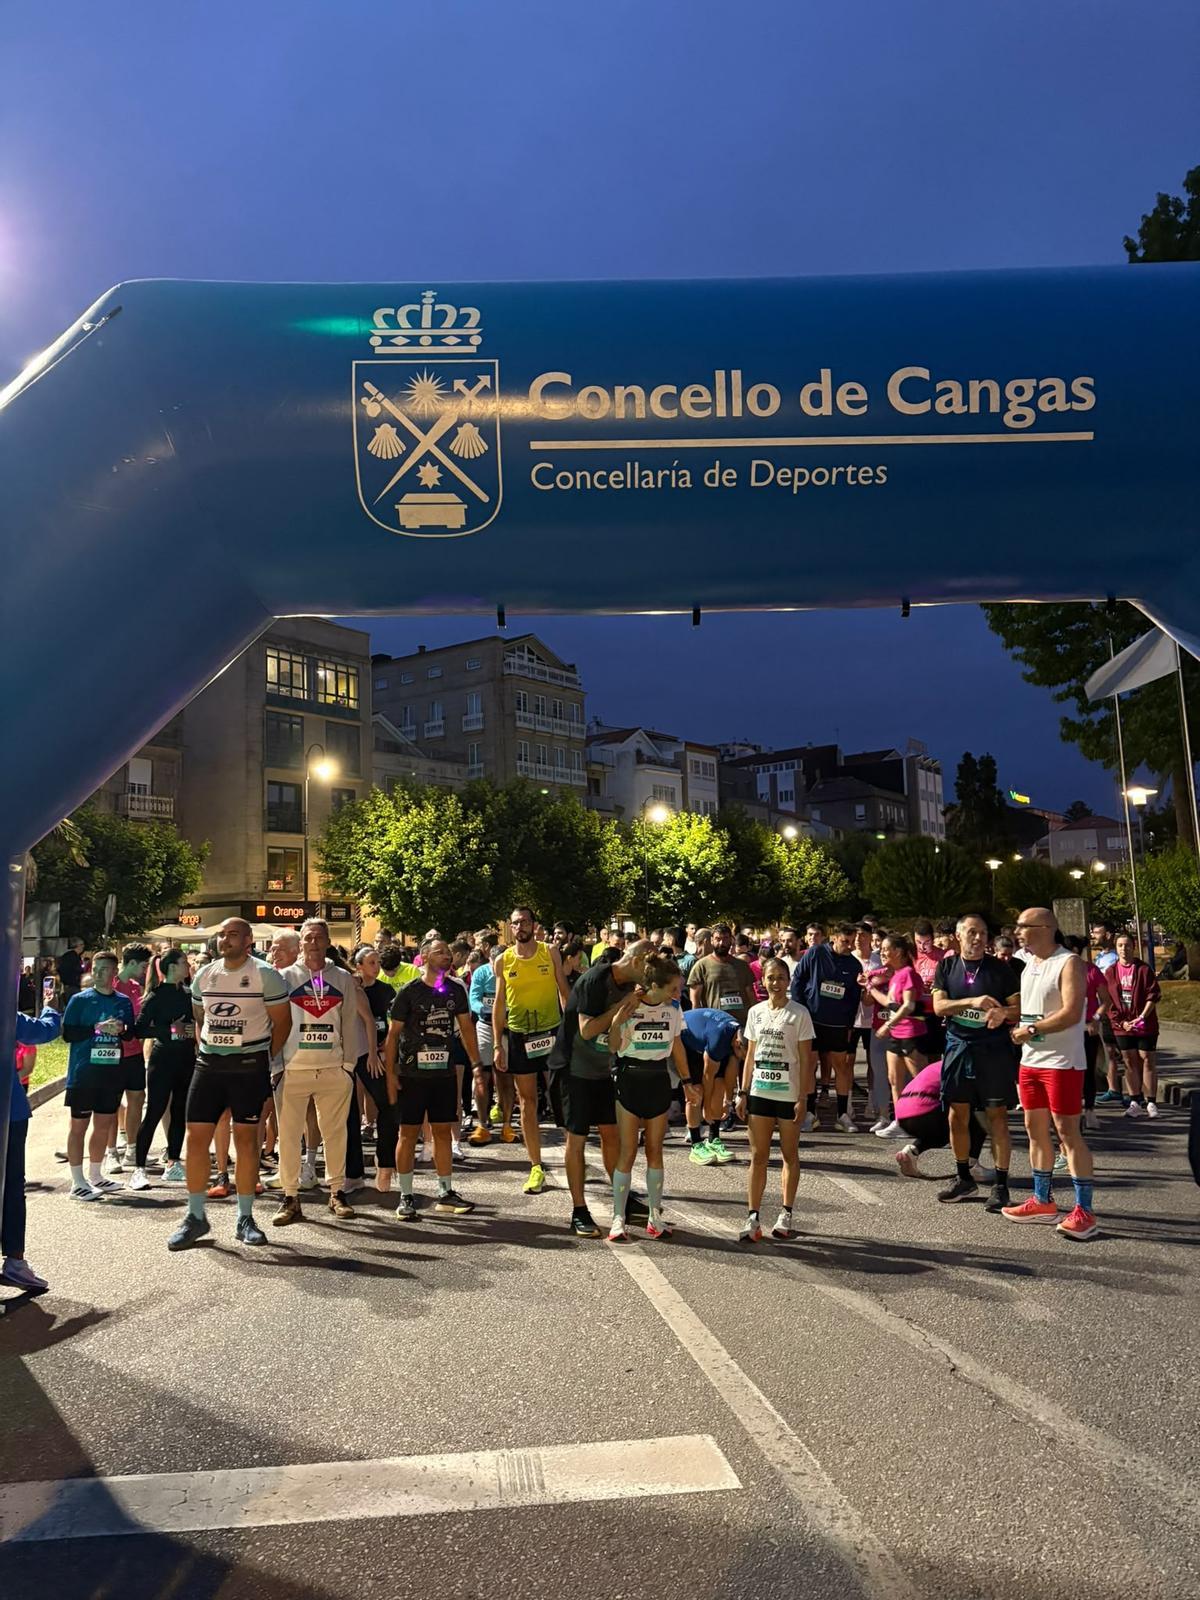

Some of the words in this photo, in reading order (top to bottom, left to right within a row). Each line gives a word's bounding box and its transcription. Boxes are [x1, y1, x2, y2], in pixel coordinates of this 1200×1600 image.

[528, 369, 781, 421] Concello
[800, 368, 868, 416] de
[887, 366, 1097, 429] Cangas
[530, 459, 693, 491] Concellaría
[703, 460, 738, 488] de
[750, 459, 888, 495] Deportes
[272, 905, 305, 919] Orange
[178, 913, 200, 926] range
[303, 999, 330, 1007] adias
[212, 1035, 235, 1045] 0365
[306, 1033, 328, 1042] 0140
[641, 1032, 664, 1041] 0744
[531, 1039, 551, 1050] 0609
[97, 1049, 116, 1057] 0266
[425, 1052, 445, 1061] 1025
[760, 1071, 782, 1081] 0809
